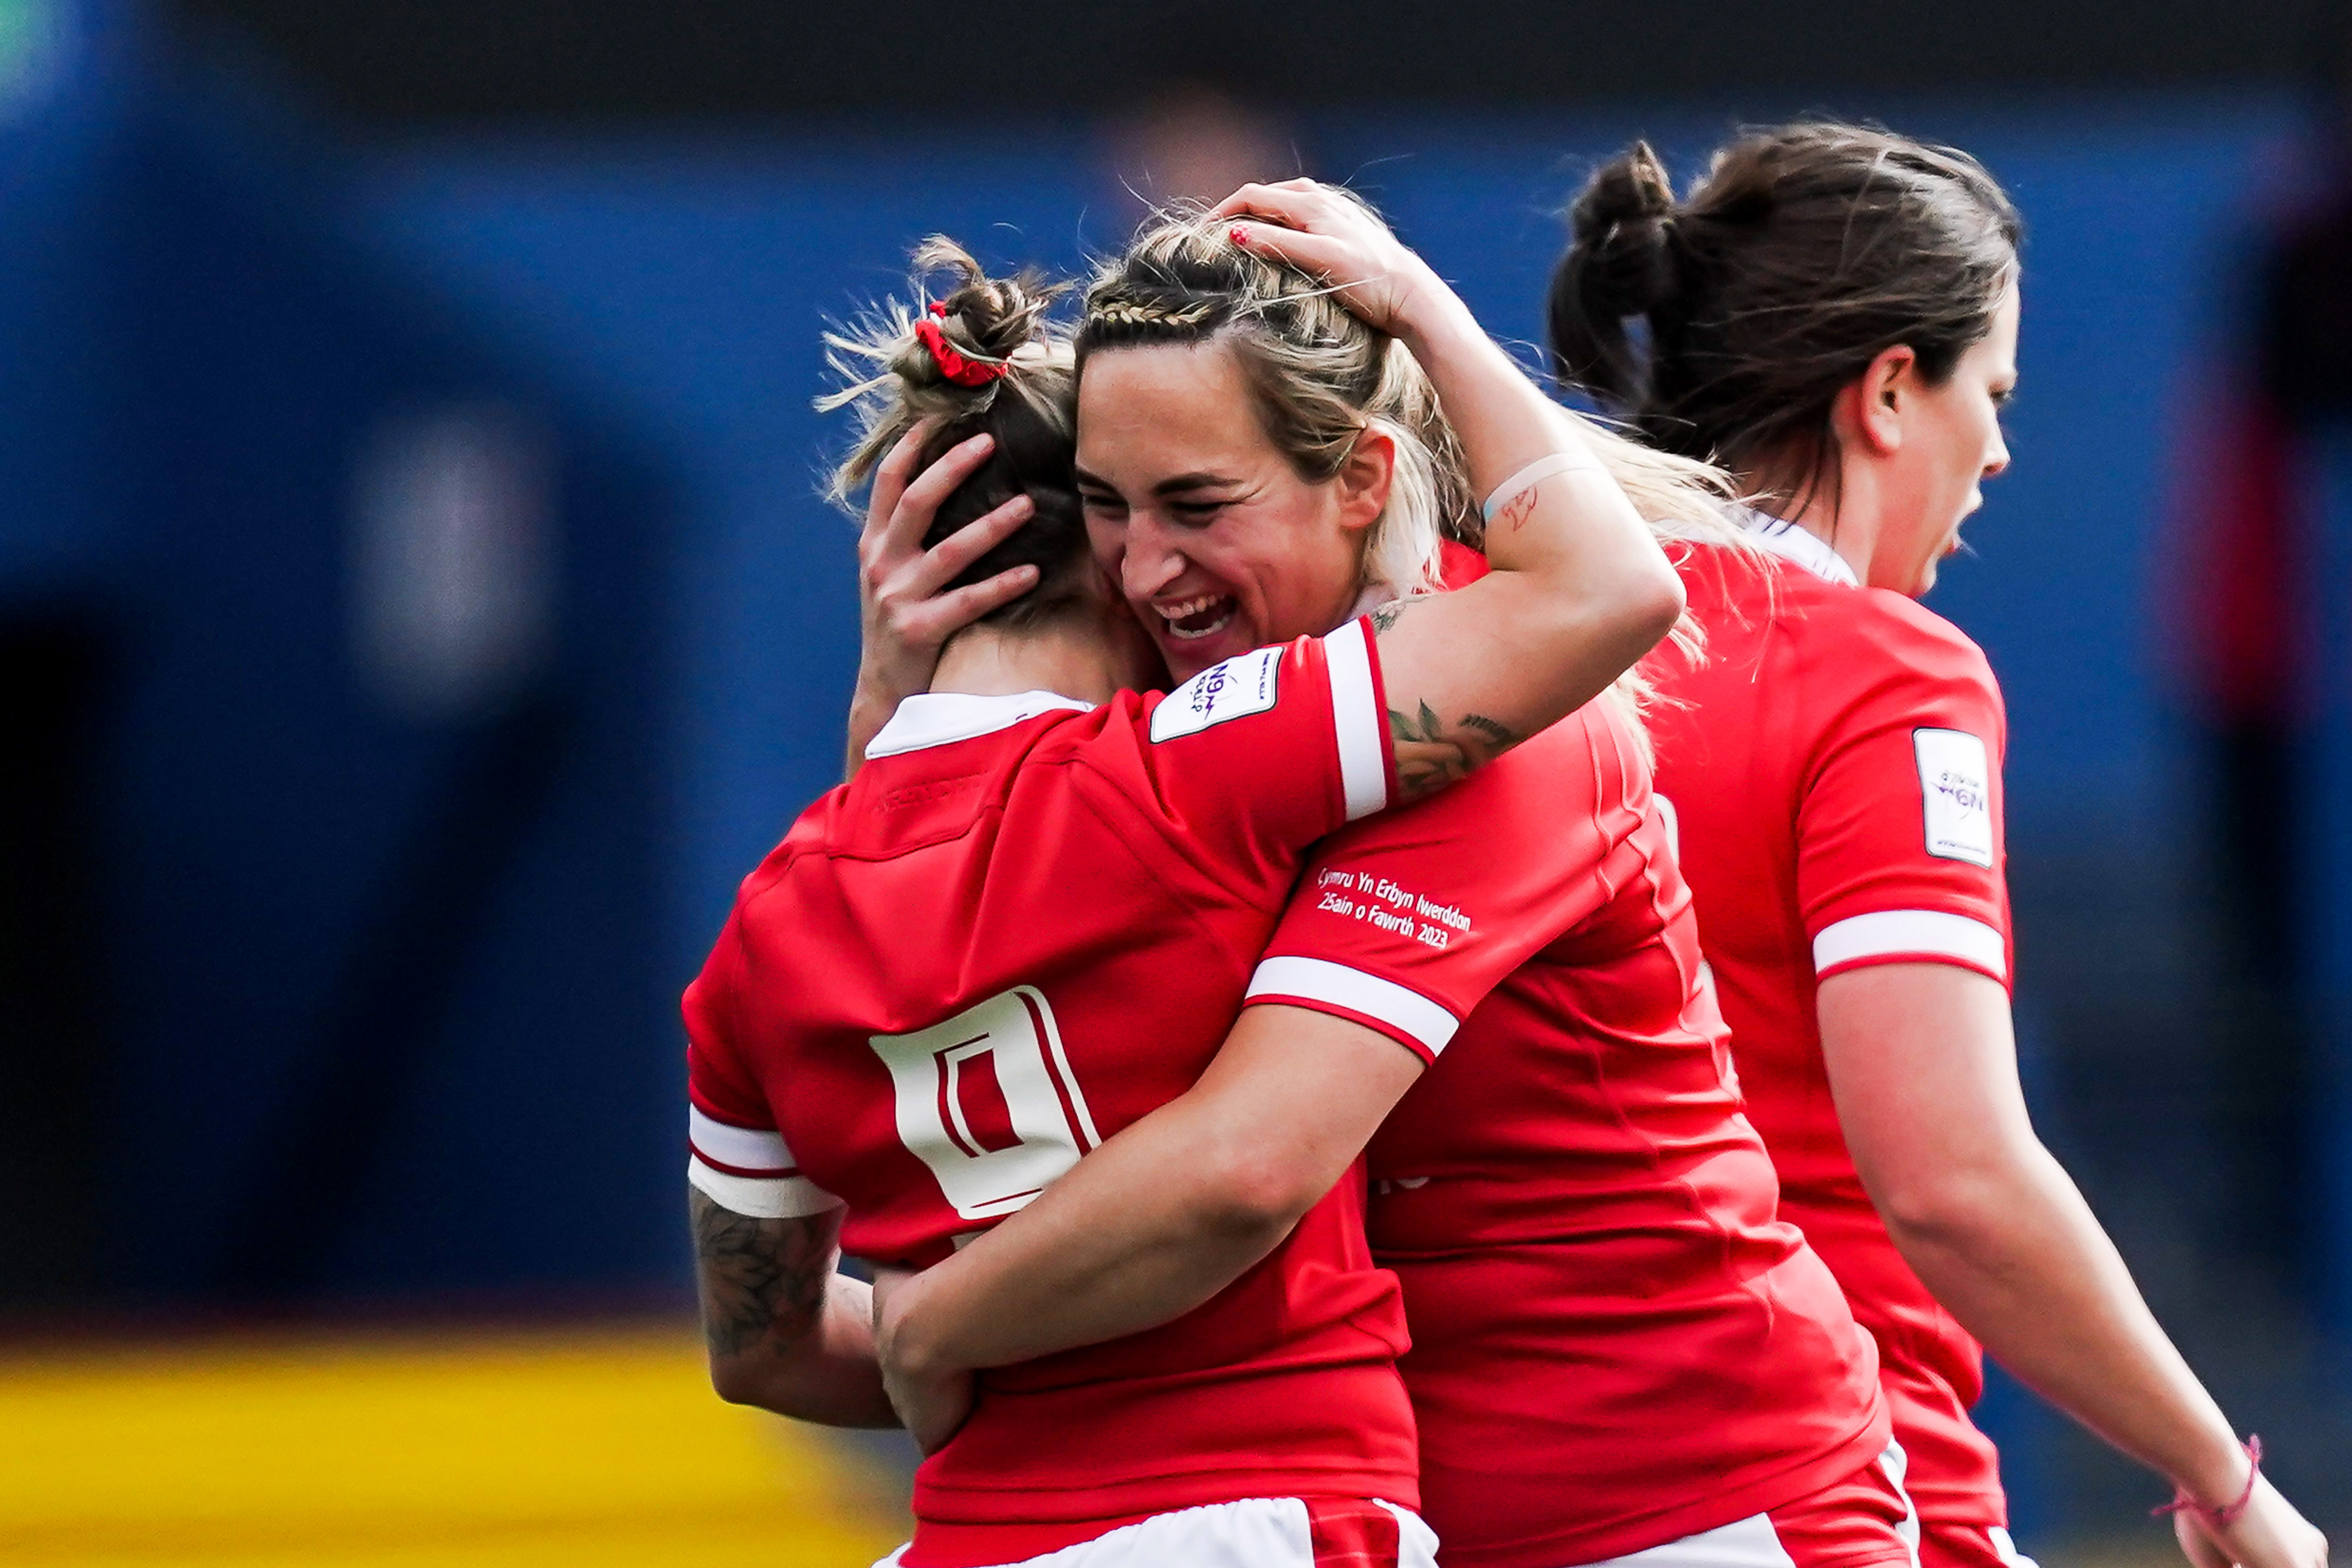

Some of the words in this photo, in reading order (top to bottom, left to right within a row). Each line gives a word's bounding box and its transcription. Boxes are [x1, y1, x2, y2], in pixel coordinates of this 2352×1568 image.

[1317, 892, 1354, 916] 25ain
[1355, 905, 1366, 919] o
[1367, 905, 1414, 938] Fawrth
[1417, 923, 1449, 950] 2023
[1357, 871, 1375, 894] Yn
[1375, 878, 1414, 909] Erbyn
[1416, 893, 1472, 933] Iwerddon
[868, 984, 1103, 1250] 9
